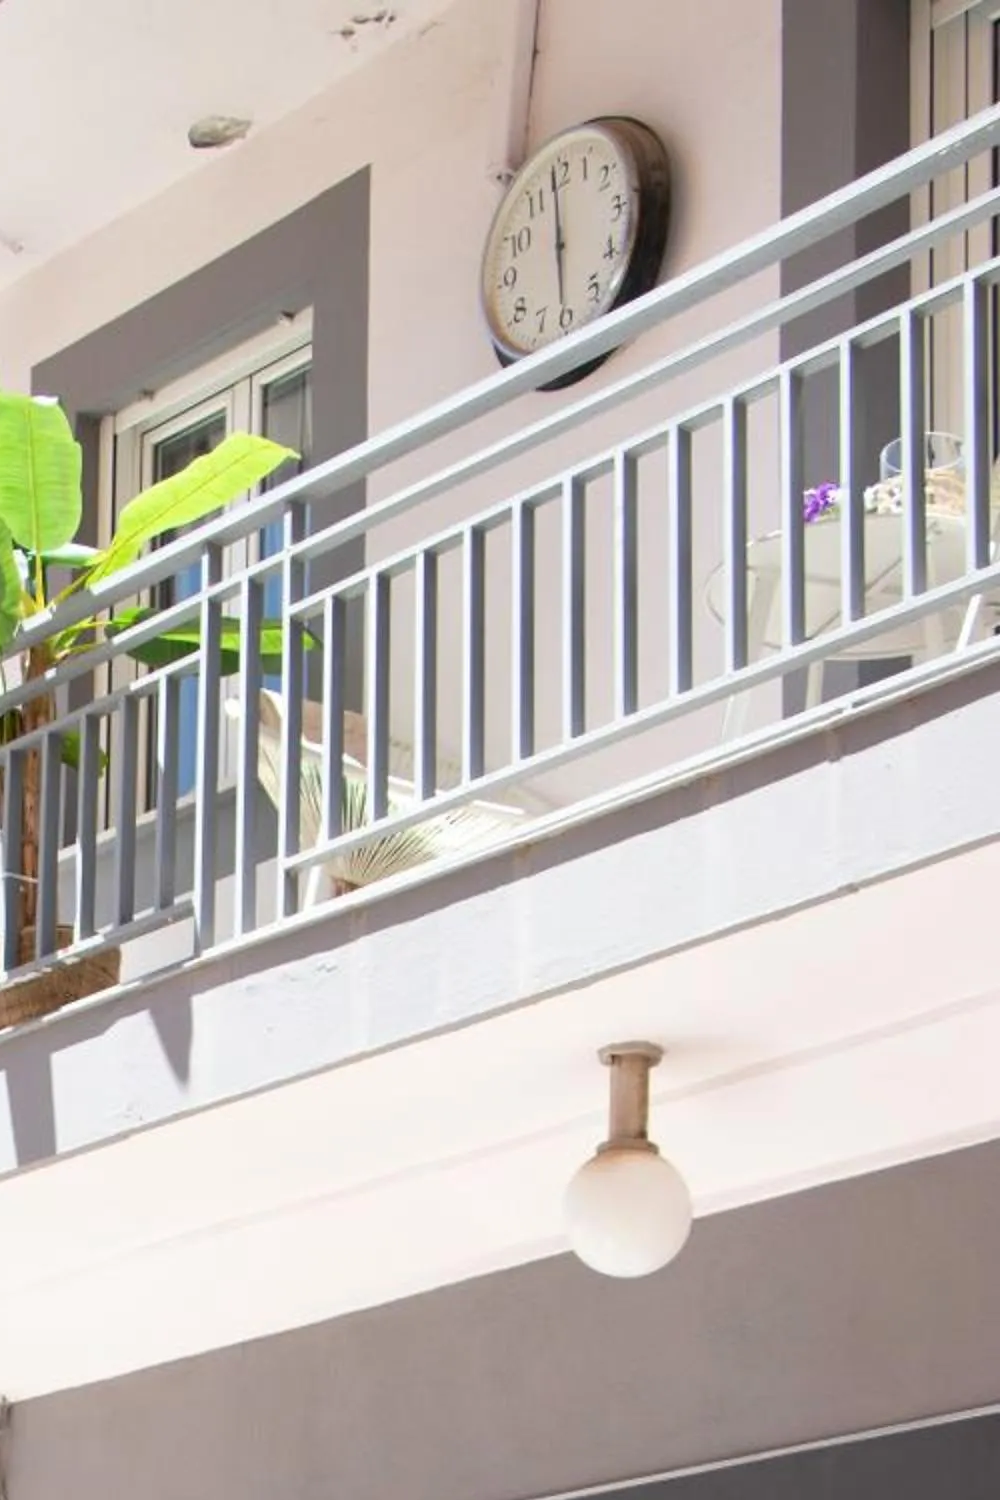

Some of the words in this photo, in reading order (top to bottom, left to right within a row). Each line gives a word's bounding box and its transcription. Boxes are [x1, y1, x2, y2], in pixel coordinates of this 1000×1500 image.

[598, 164, 611, 193] 2
[528, 188, 545, 219] 11
[510, 225, 531, 258] 10
[503, 266, 517, 291] 9
[513, 296, 527, 324] 8
[535, 305, 549, 334] 7
[559, 305, 573, 330] 6
